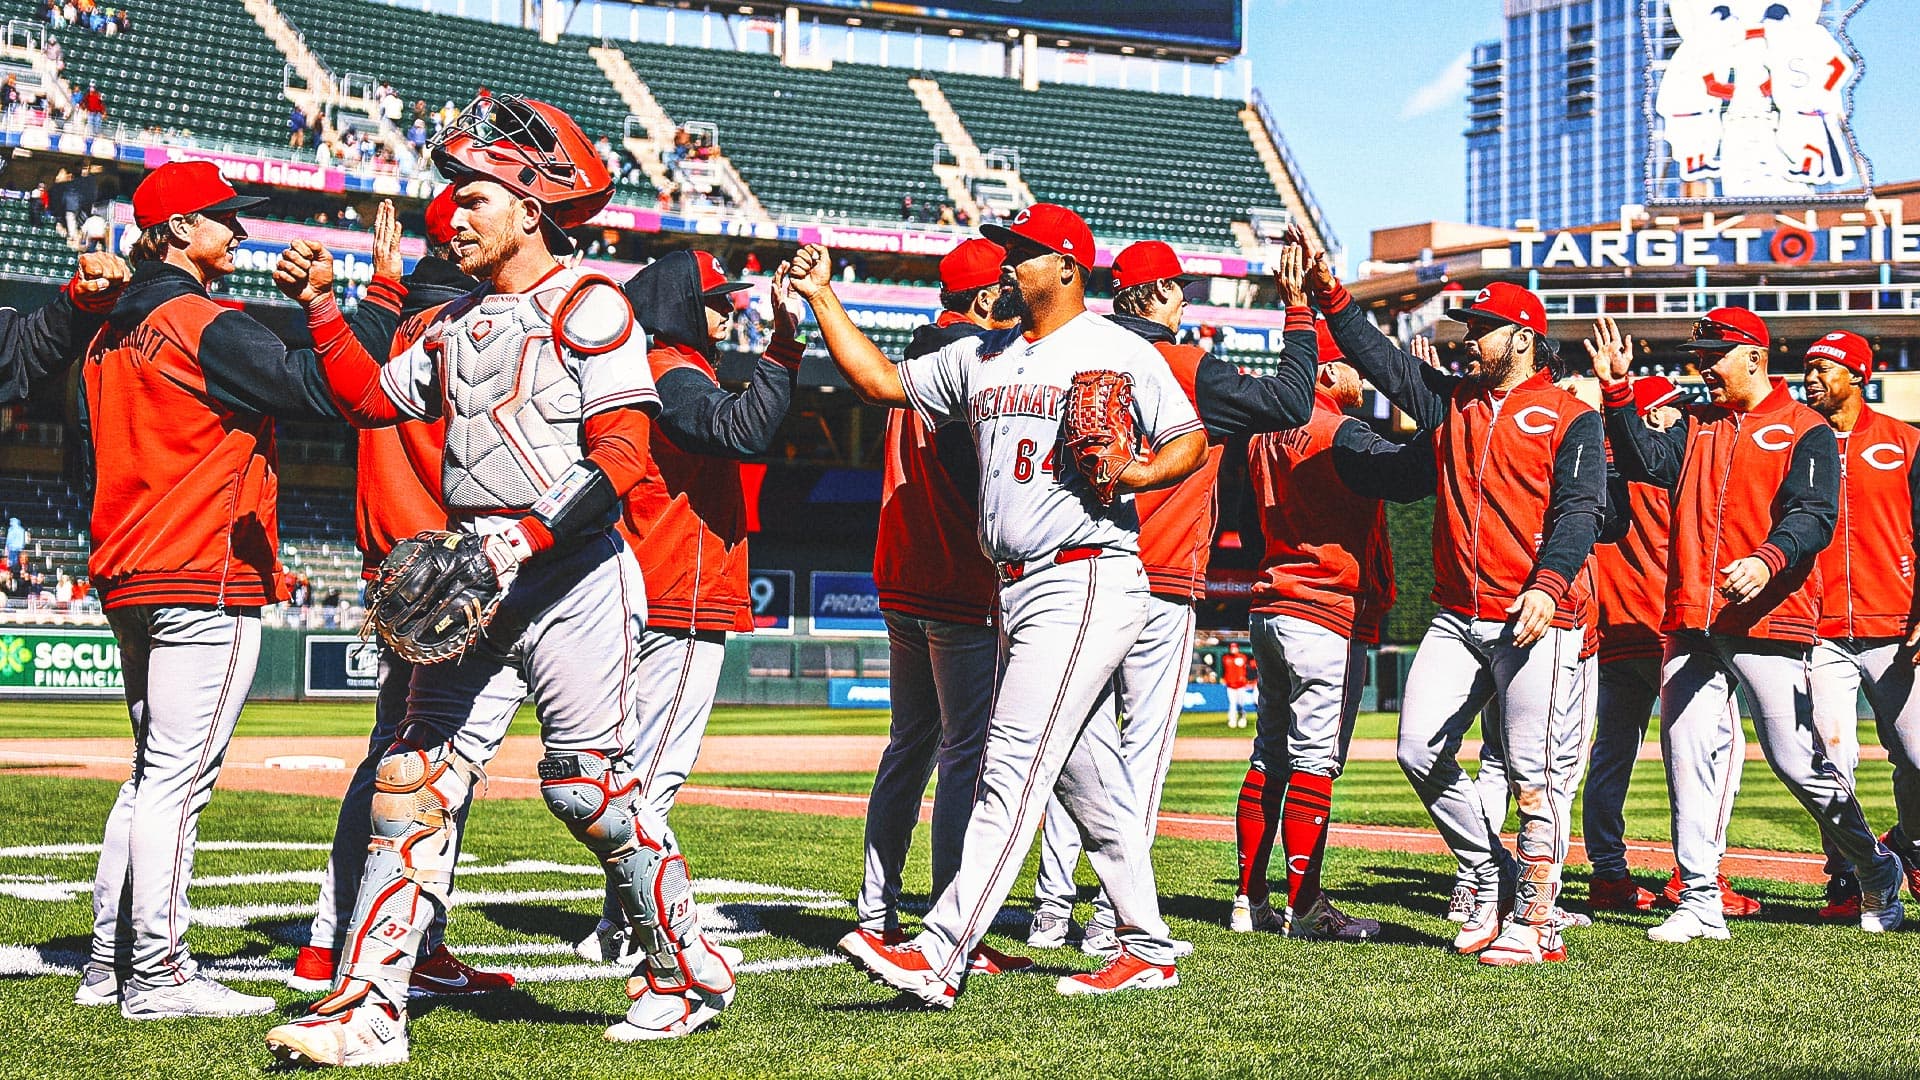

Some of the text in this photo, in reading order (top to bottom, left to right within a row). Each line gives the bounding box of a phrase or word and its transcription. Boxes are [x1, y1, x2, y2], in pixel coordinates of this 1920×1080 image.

[263, 160, 326, 189] Island
[818, 226, 901, 251] Treasure
[1514, 228, 1762, 268] TARGET
[1513, 405, 1559, 435] C
[1751, 423, 1795, 452] C
[1014, 438, 1066, 485] 64
[1860, 442, 1905, 471] C
[677, 898, 689, 918] 37
[383, 922, 408, 940] 37
